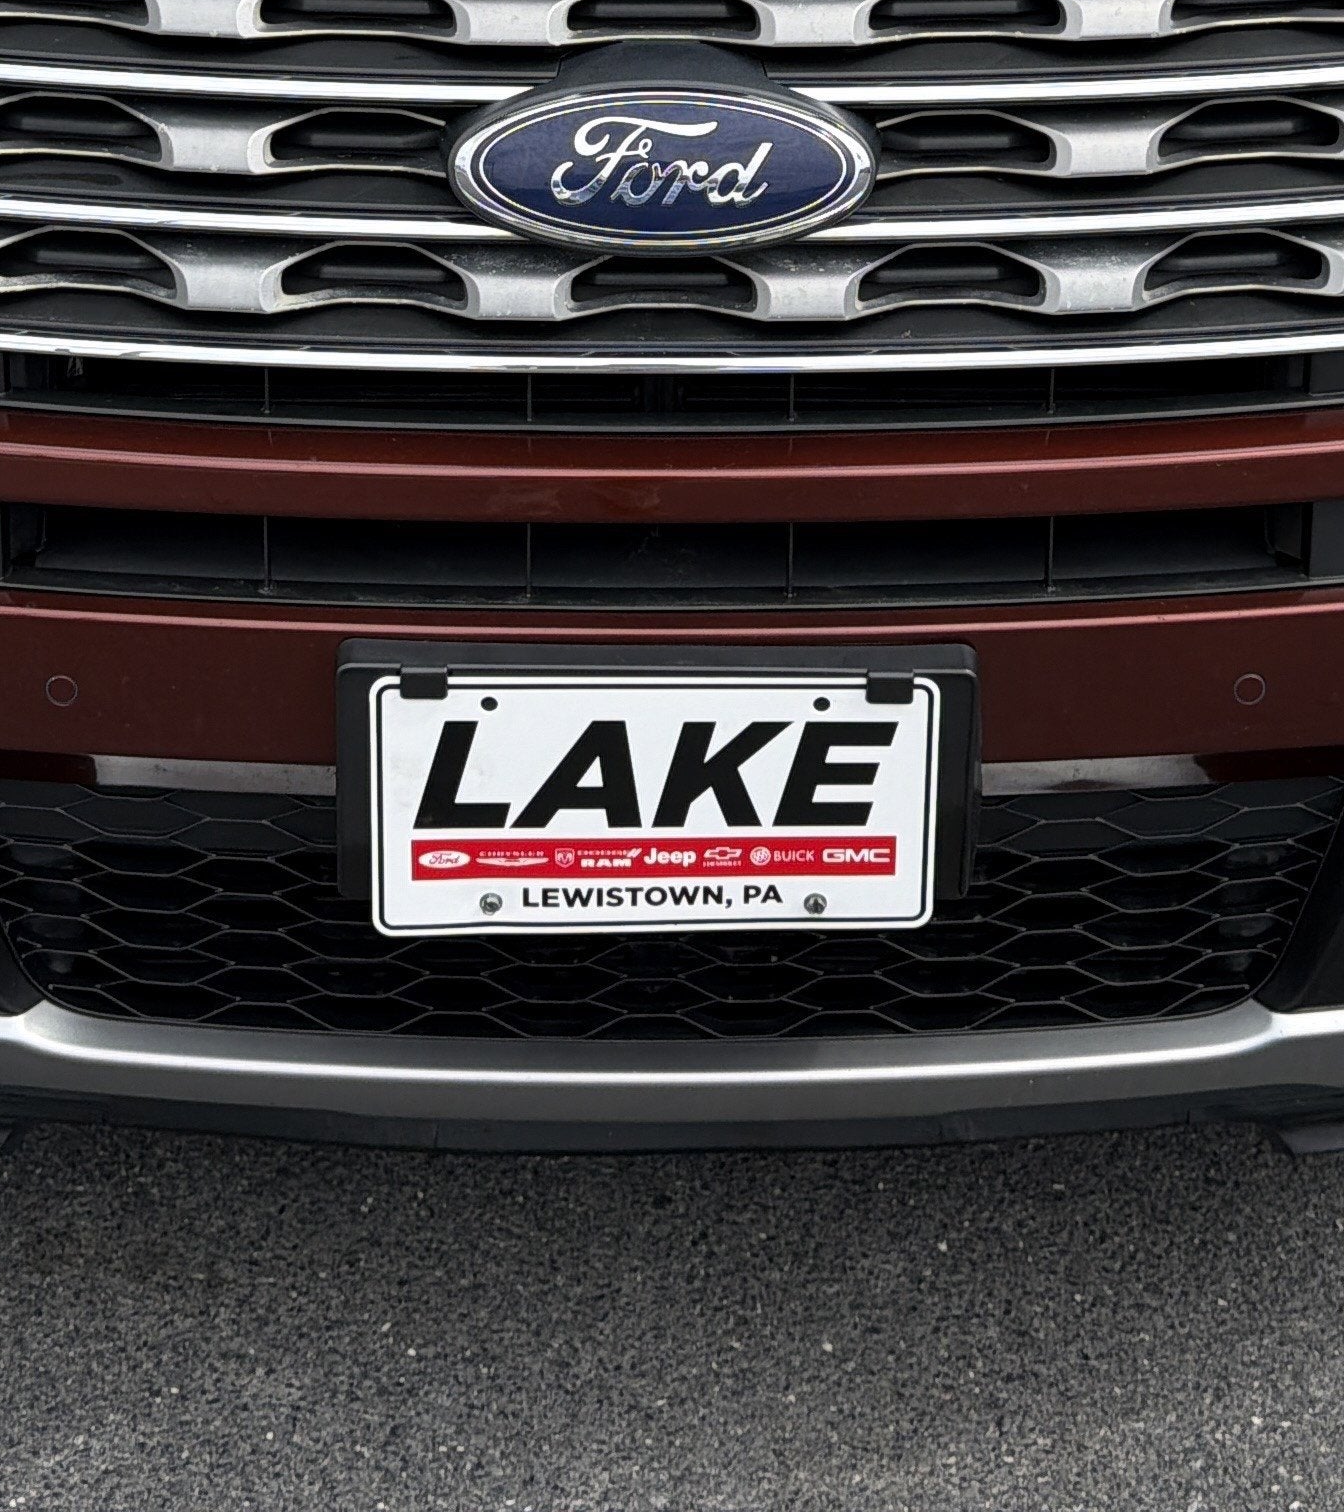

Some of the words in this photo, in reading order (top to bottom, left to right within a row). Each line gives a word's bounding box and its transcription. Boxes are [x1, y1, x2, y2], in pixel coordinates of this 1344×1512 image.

[551, 115, 774, 206] Ford
[412, 720, 899, 829] LAKE
[580, 858, 633, 869] RAM
[643, 847, 697, 868] Jeep
[773, 849, 815, 863] BUICK
[822, 847, 891, 864] GMC
[522, 885, 733, 910] LEWISTOWN,
[743, 884, 783, 906] PA
